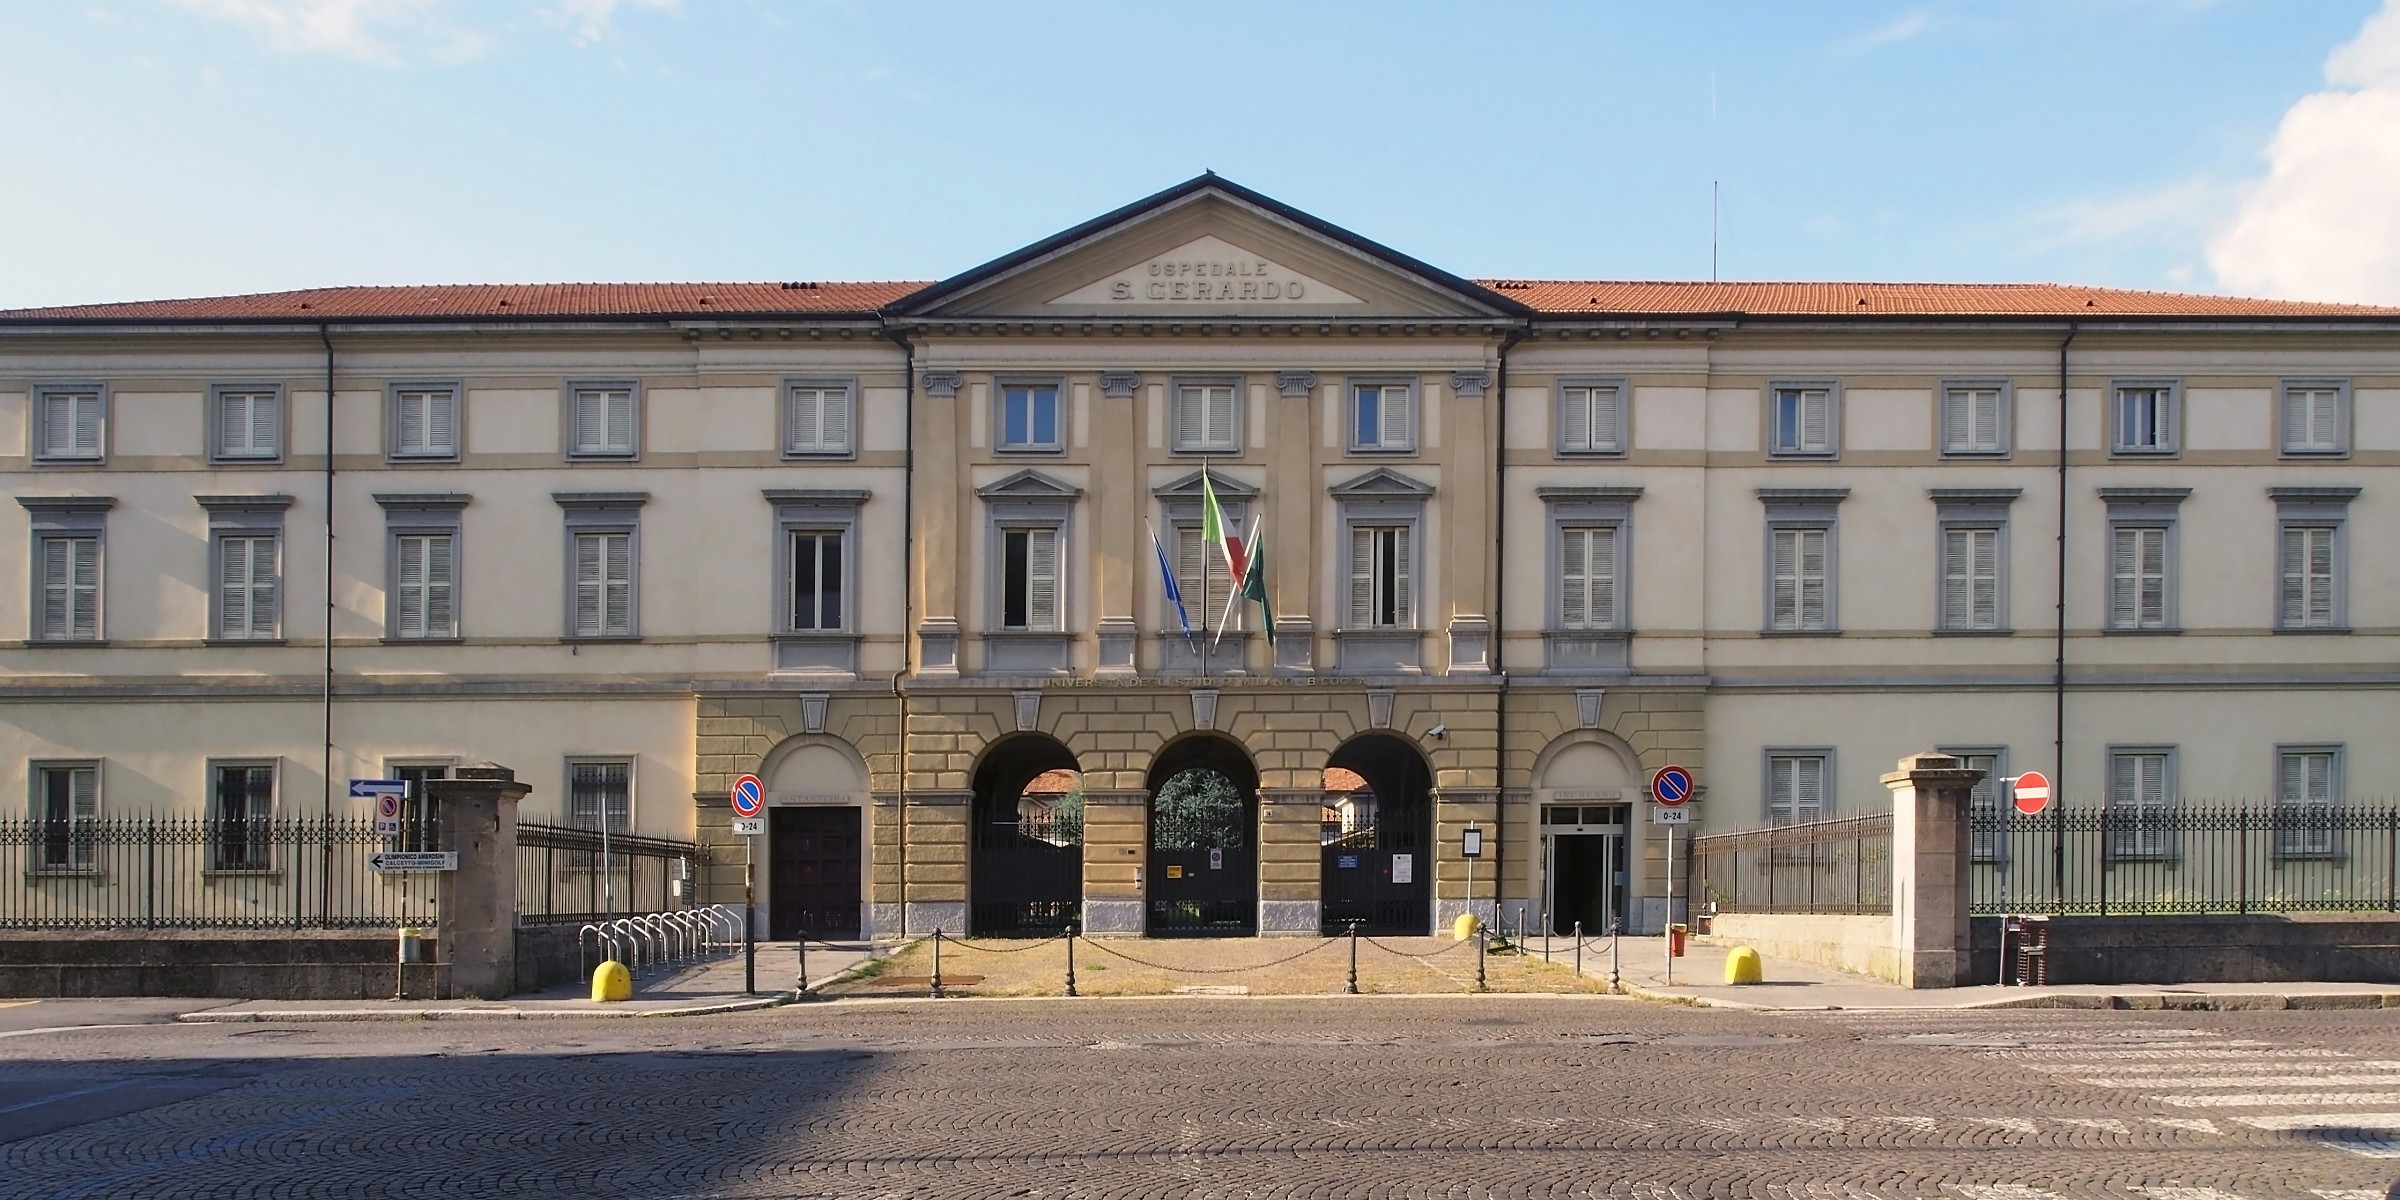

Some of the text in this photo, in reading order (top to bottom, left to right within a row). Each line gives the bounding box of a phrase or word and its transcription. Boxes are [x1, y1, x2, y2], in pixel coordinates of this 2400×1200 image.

[1148, 262, 1268, 277] OSPEDALE
[1111, 280, 1304, 300] S. GERARDO
[1175, 677, 1216, 687] STUDI
[1307, 677, 1367, 687] BCOCCA
[1663, 811, 1682, 820] 0-24
